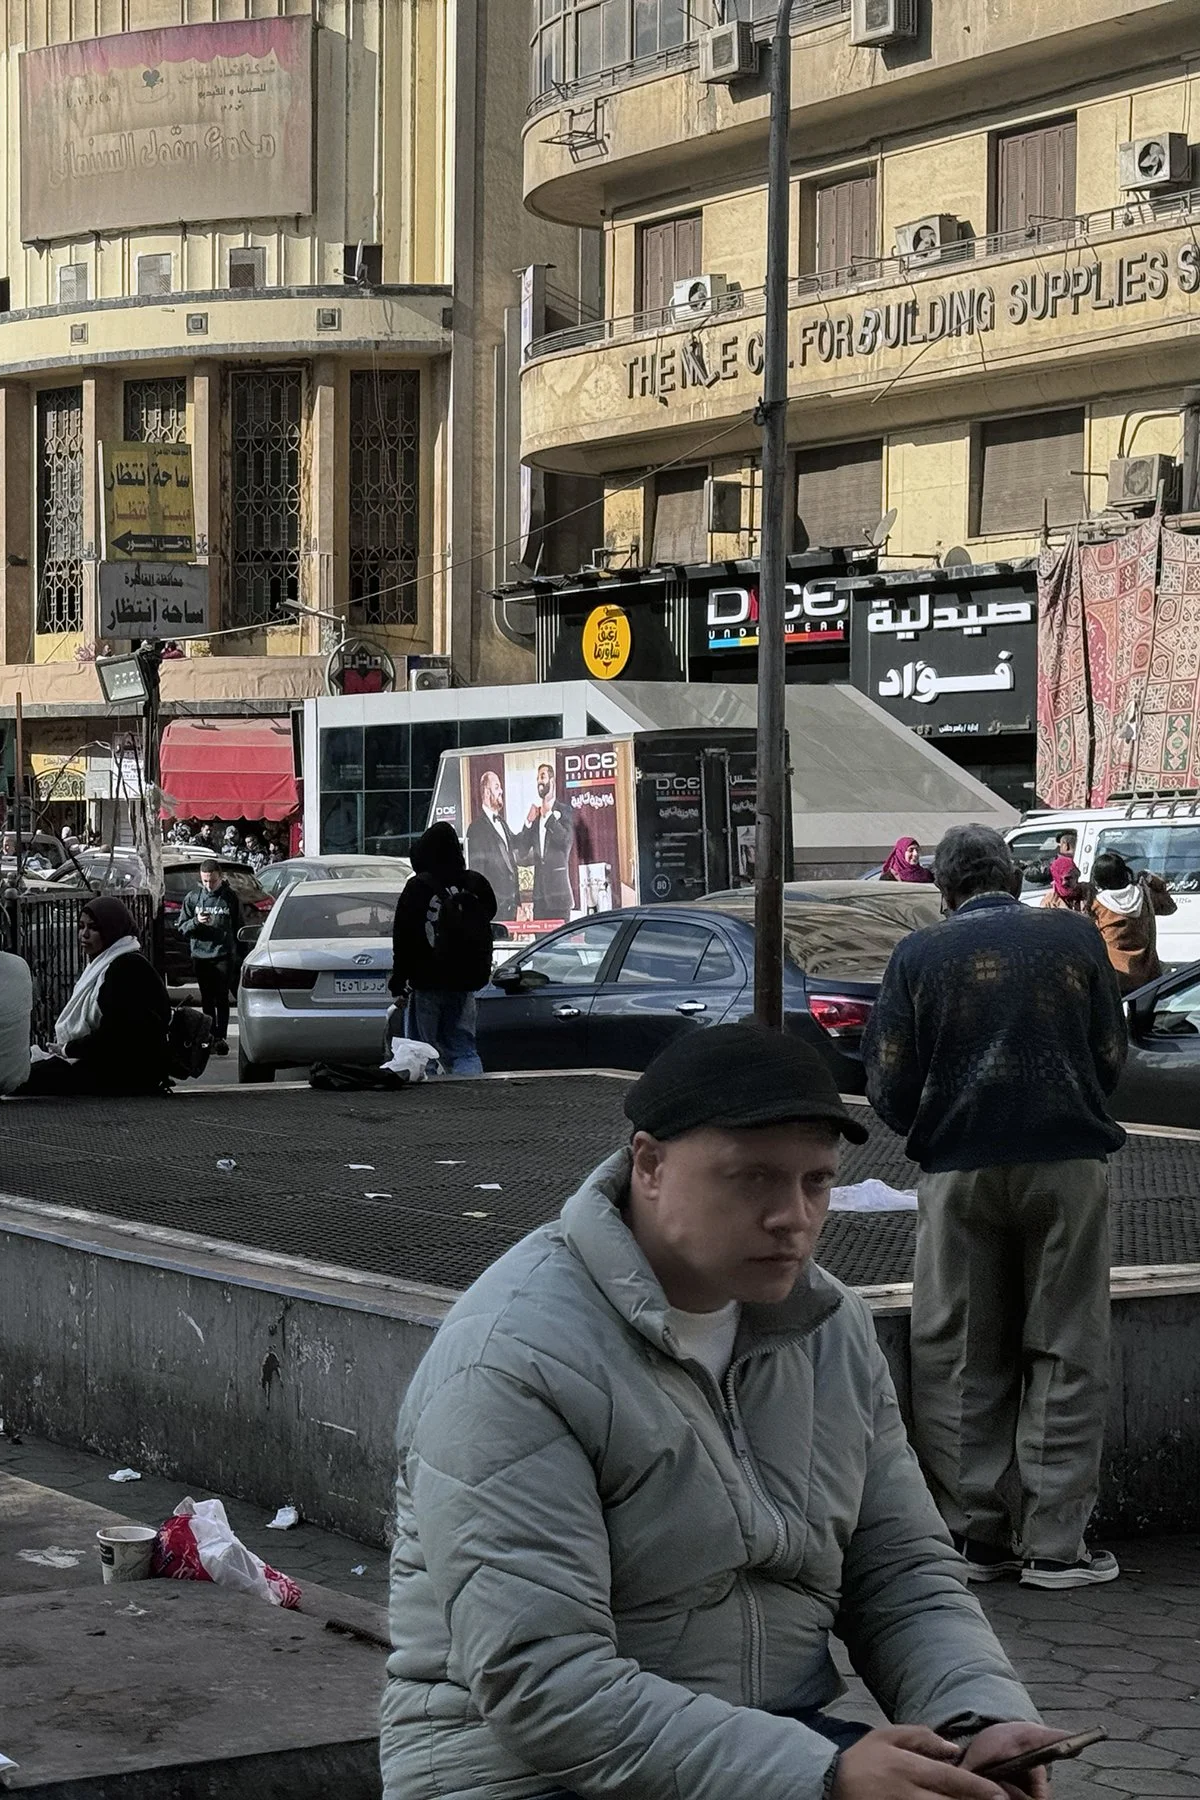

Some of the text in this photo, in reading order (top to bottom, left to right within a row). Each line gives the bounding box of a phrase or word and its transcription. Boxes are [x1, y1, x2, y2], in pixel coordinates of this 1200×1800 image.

[623, 349, 676, 400] THE
[800, 313, 855, 367] FOR
[856, 286, 996, 356] BUILDING
[1007, 249, 1169, 325] SUPPLIES
[153, 462, 190, 488] ساحة
[161, 598, 204, 624] ساحة
[867, 594, 1032, 640] صيدلية
[708, 619, 844, 640] UNDEWEAR
[878, 650, 1013, 703] فؤاد
[565, 752, 618, 772] DICE
[656, 777, 700, 790] DCE
